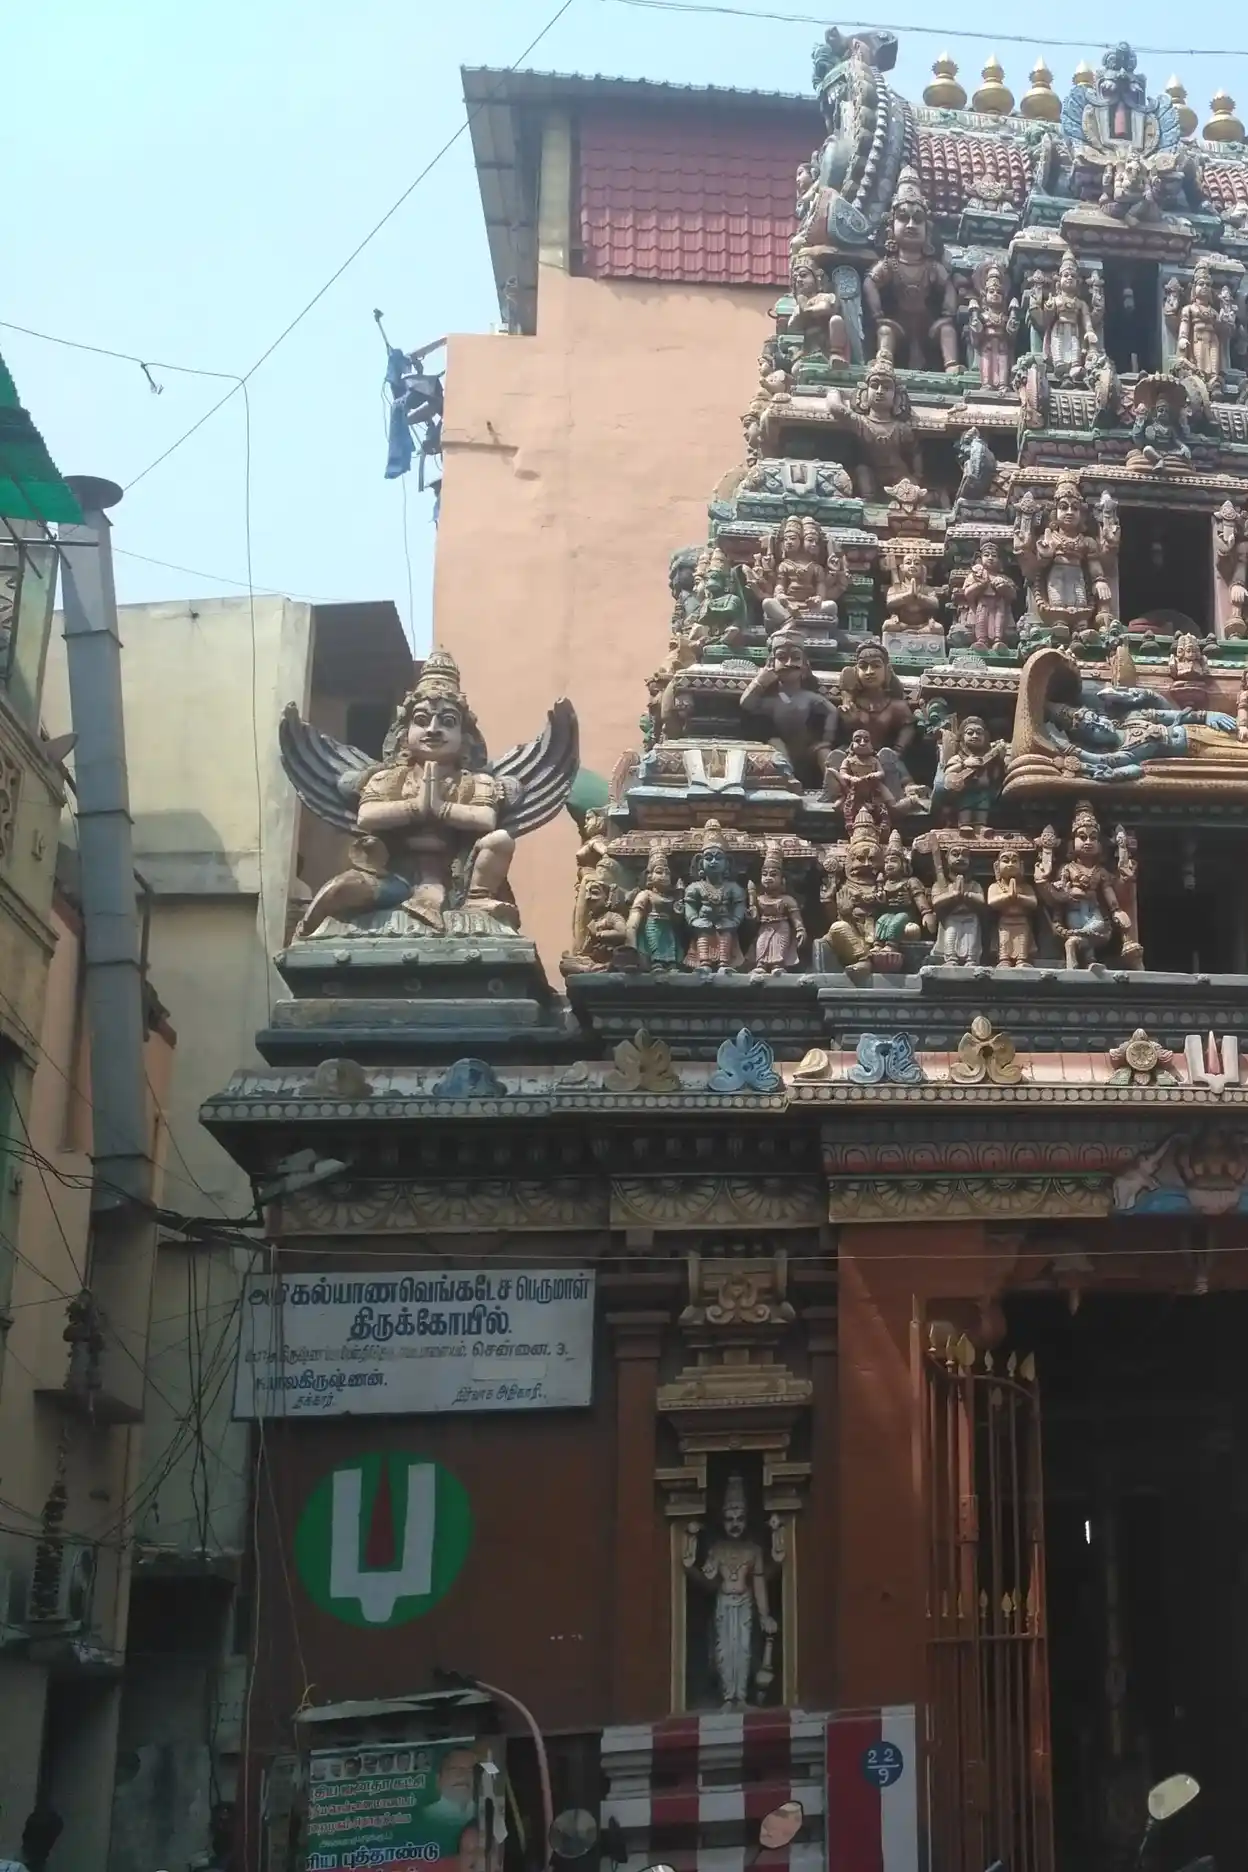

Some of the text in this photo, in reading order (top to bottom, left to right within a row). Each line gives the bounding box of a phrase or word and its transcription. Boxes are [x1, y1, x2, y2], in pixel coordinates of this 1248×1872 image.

[517, 1273, 590, 1304] பெருமாள்
[878, 1768, 889, 1785] 9
[341, 1841, 440, 1869] புத்தாண்டு
